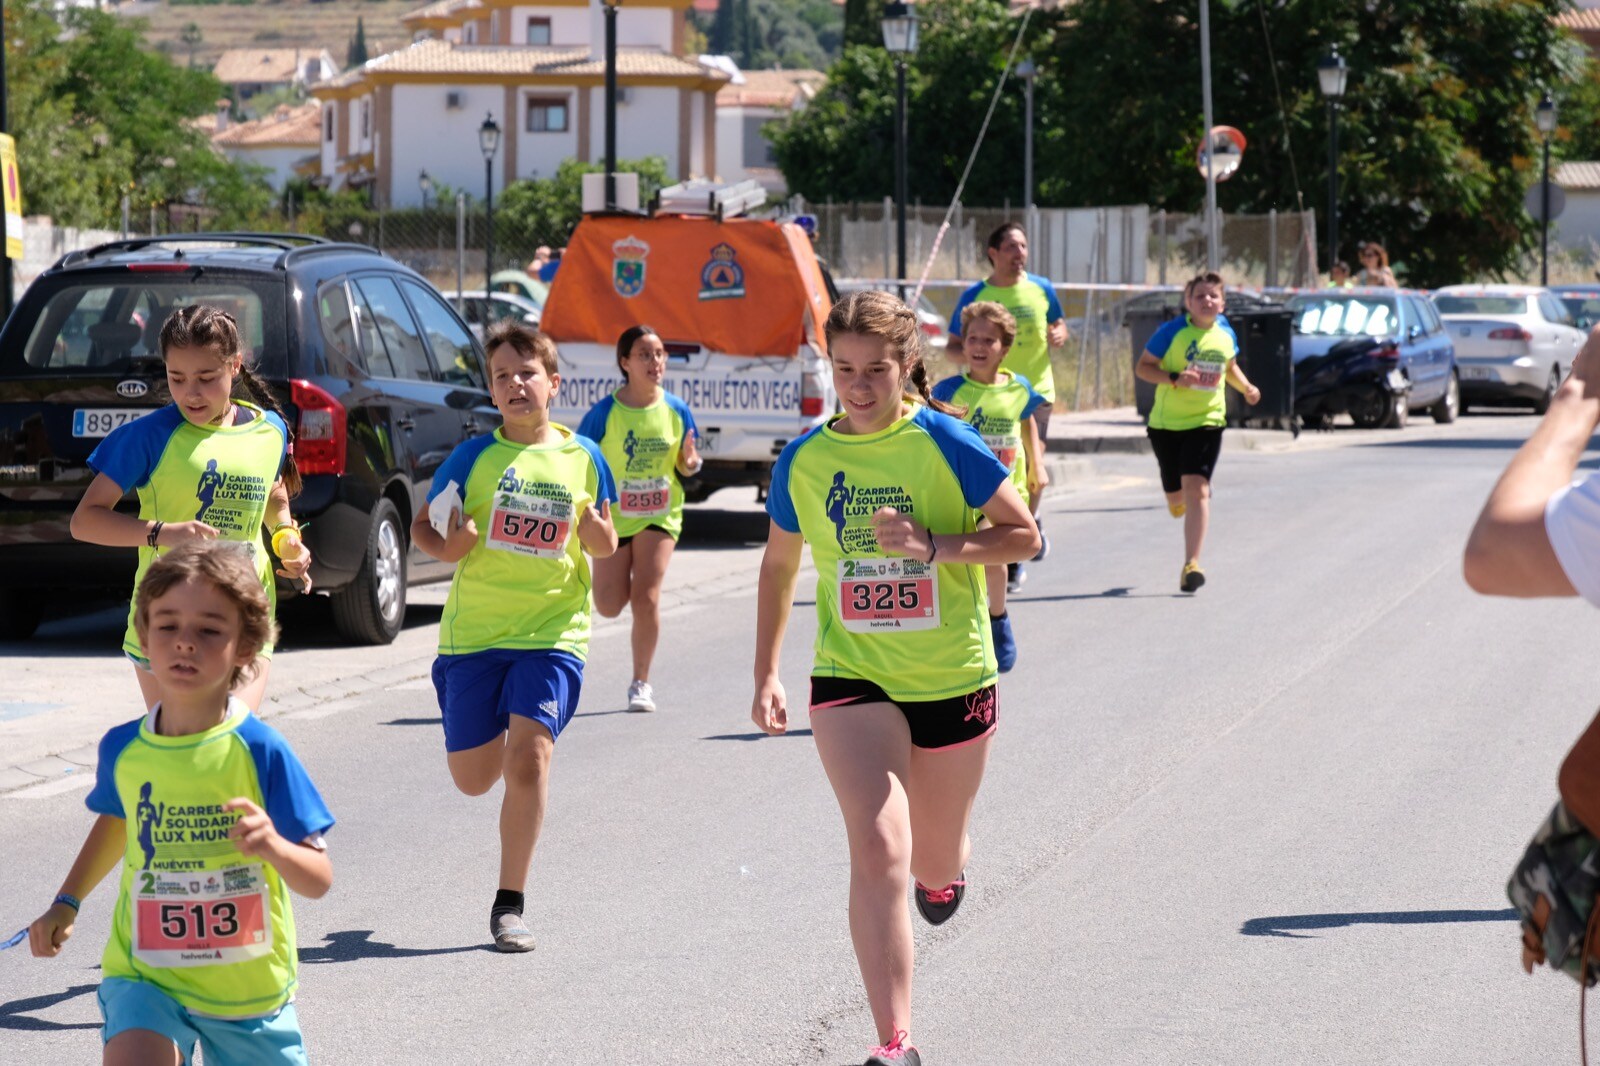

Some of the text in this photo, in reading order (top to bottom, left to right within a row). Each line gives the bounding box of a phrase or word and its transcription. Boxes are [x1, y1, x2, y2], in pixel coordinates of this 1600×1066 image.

[121, 383, 143, 394] KIA
[763, 380, 802, 410] VEGA
[229, 475, 264, 484] CARRERA
[526, 481, 567, 491] CARRERA
[858, 486, 904, 496] CARRERA
[216, 491, 265, 502] LUX MUNDI
[523, 488, 573, 499] SOLIDARIA
[627, 492, 662, 508] 258
[856, 495, 912, 506] SOLIDARIA
[208, 508, 242, 517] MUÉVETE
[846, 504, 914, 516] LUX MNDI
[204, 514, 234, 522] CONTRA
[212, 520, 242, 530] CÁNCER
[503, 514, 558, 543] 570
[856, 538, 878, 548] CÁNC
[844, 560, 856, 577] 2
[853, 583, 918, 610] 325
[154, 828, 228, 843] LUX MUN
[154, 860, 204, 870] MUÉVETE
[140, 872, 156, 894] 2
[161, 902, 238, 938] 513
[181, 952, 212, 961] helvetia
